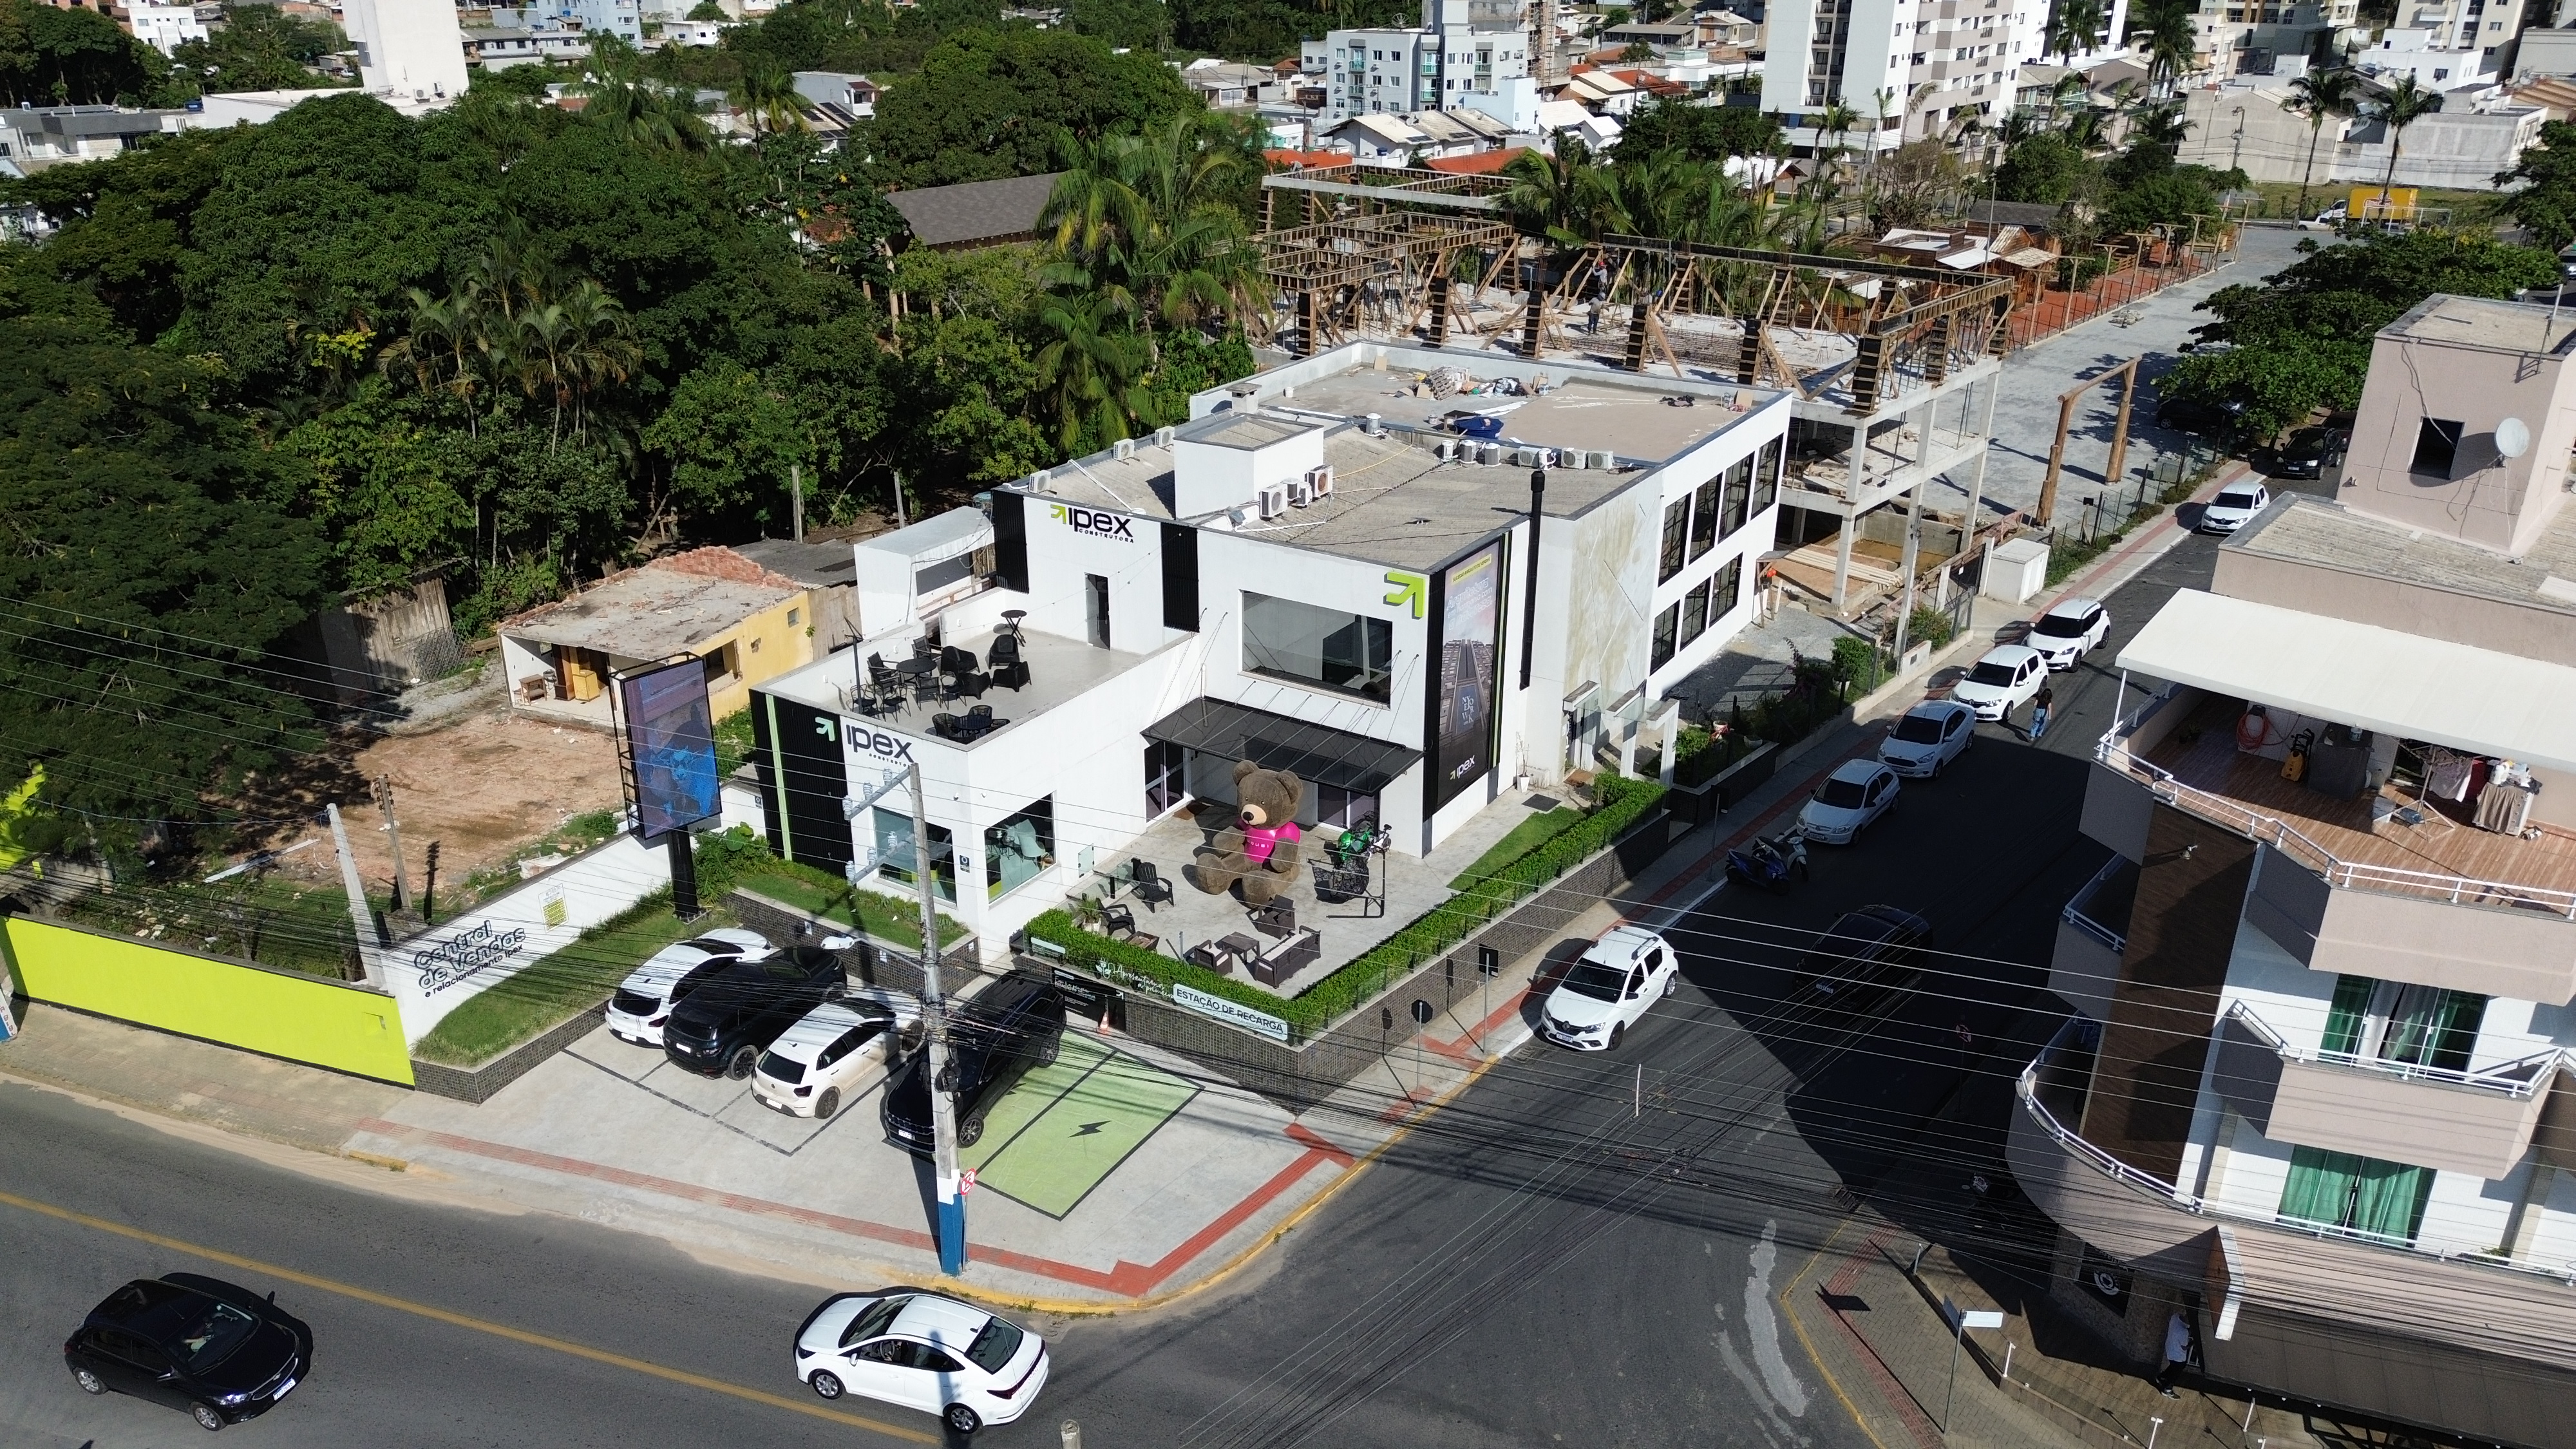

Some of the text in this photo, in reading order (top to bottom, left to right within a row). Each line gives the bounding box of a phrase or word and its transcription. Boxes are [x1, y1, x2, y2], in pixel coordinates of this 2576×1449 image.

[1079, 528, 1134, 543] CONSTRUTORA
[414, 920, 493, 969] Central
[419, 927, 526, 989] de Vendas
[433, 954, 503, 994] relacionamento
[1177, 988, 1220, 1010] ESTAÇÃO
[1222, 1004, 1235, 1015] DE
[1236, 1009, 1283, 1033] RECARGA
